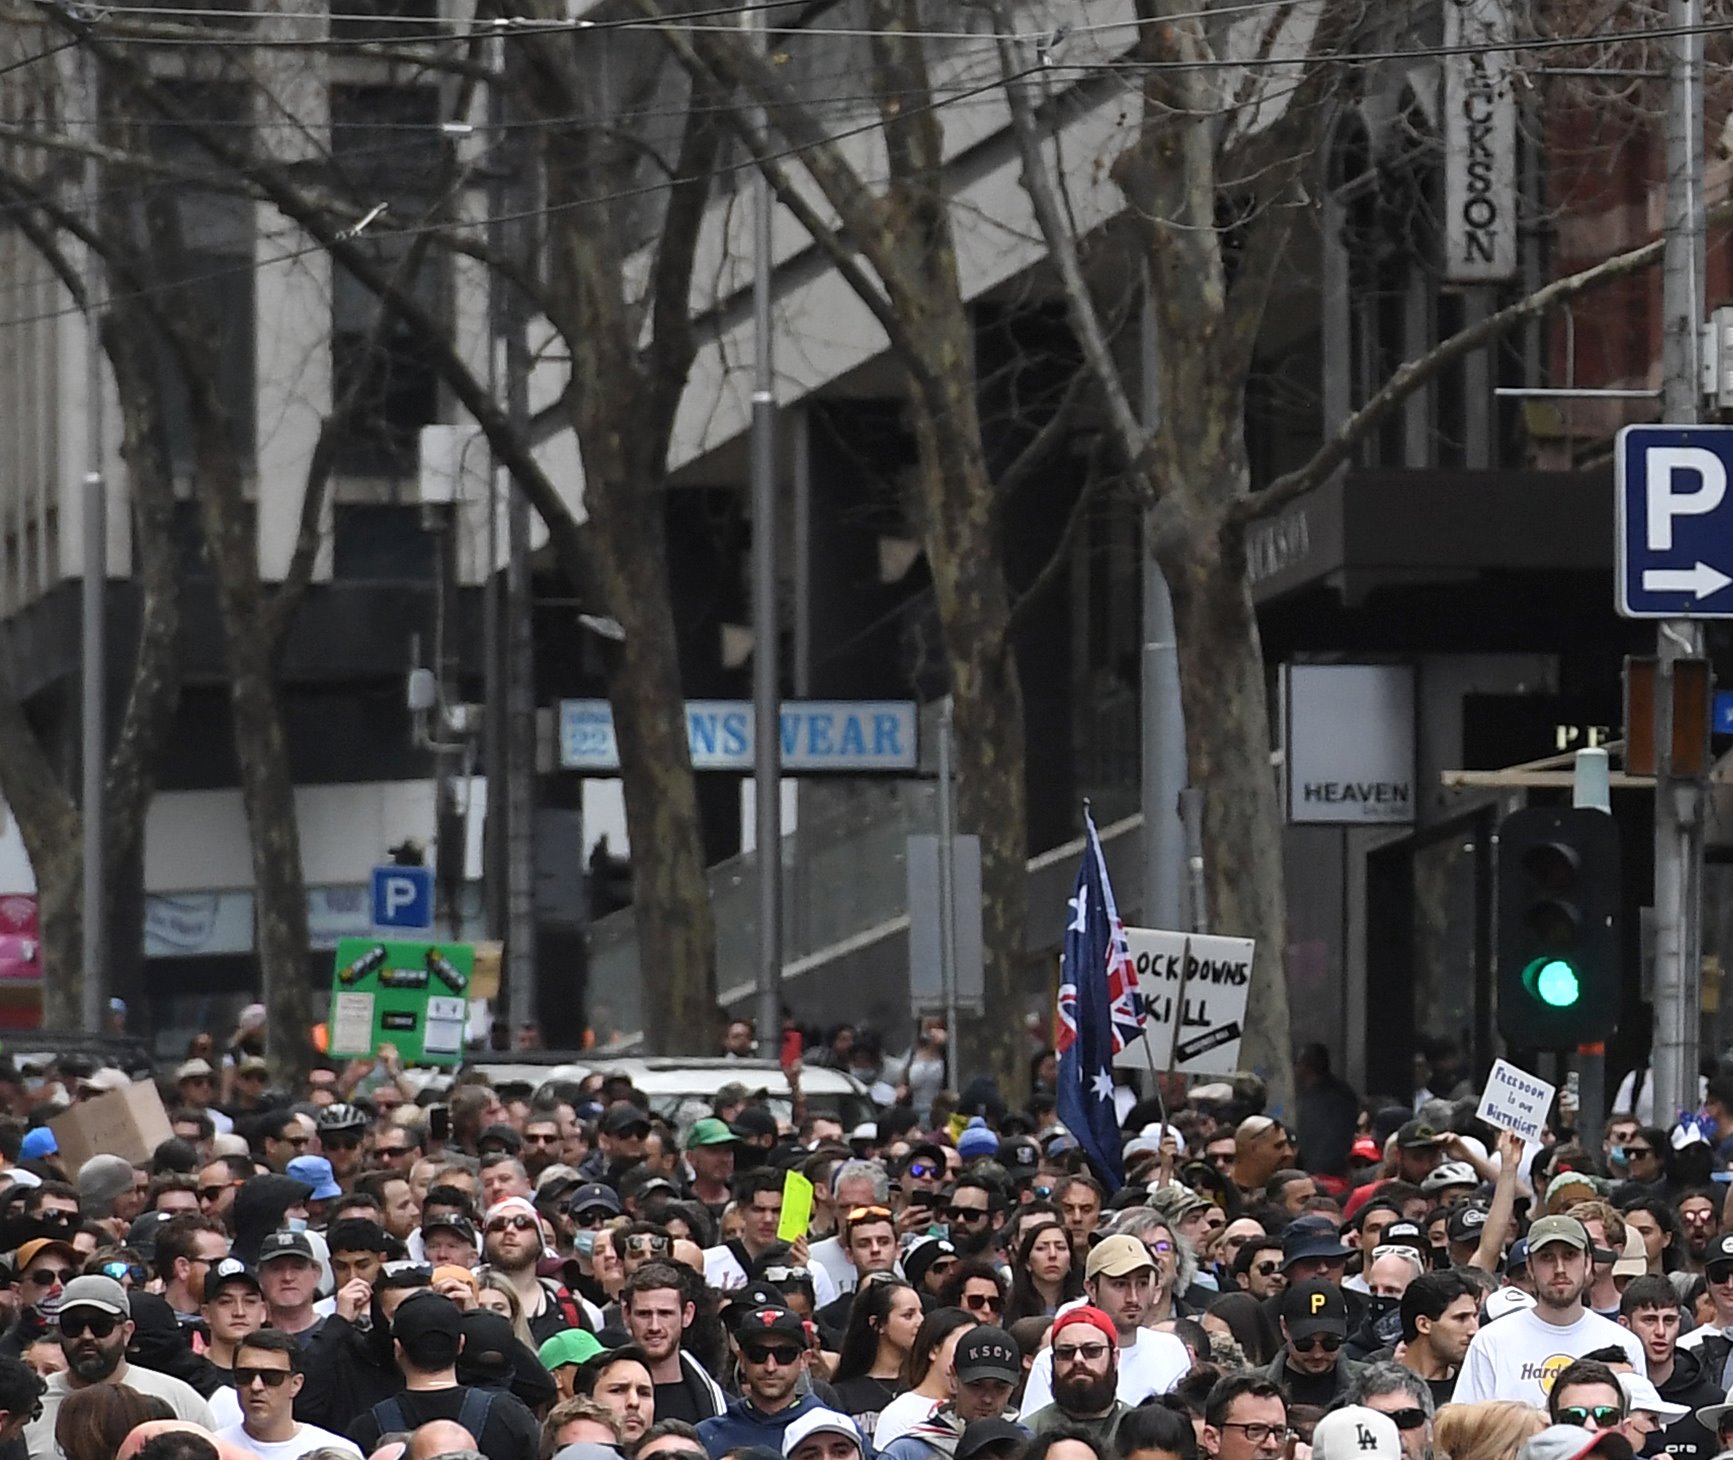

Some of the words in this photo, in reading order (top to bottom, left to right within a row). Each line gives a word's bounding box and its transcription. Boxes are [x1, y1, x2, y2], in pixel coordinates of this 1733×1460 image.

[1645, 446, 1727, 550] P
[1305, 782, 1408, 802] HEAVEN
[386, 877, 417, 919] P
[1136, 951, 1248, 986] OCKDOWNS
[1144, 993, 1212, 1027] KILL
[1311, 1293, 1326, 1314] P
[968, 1345, 1012, 1361] KSCY
[1520, 1362, 1562, 1380] Hard
[1356, 1423, 1378, 1451] LA
